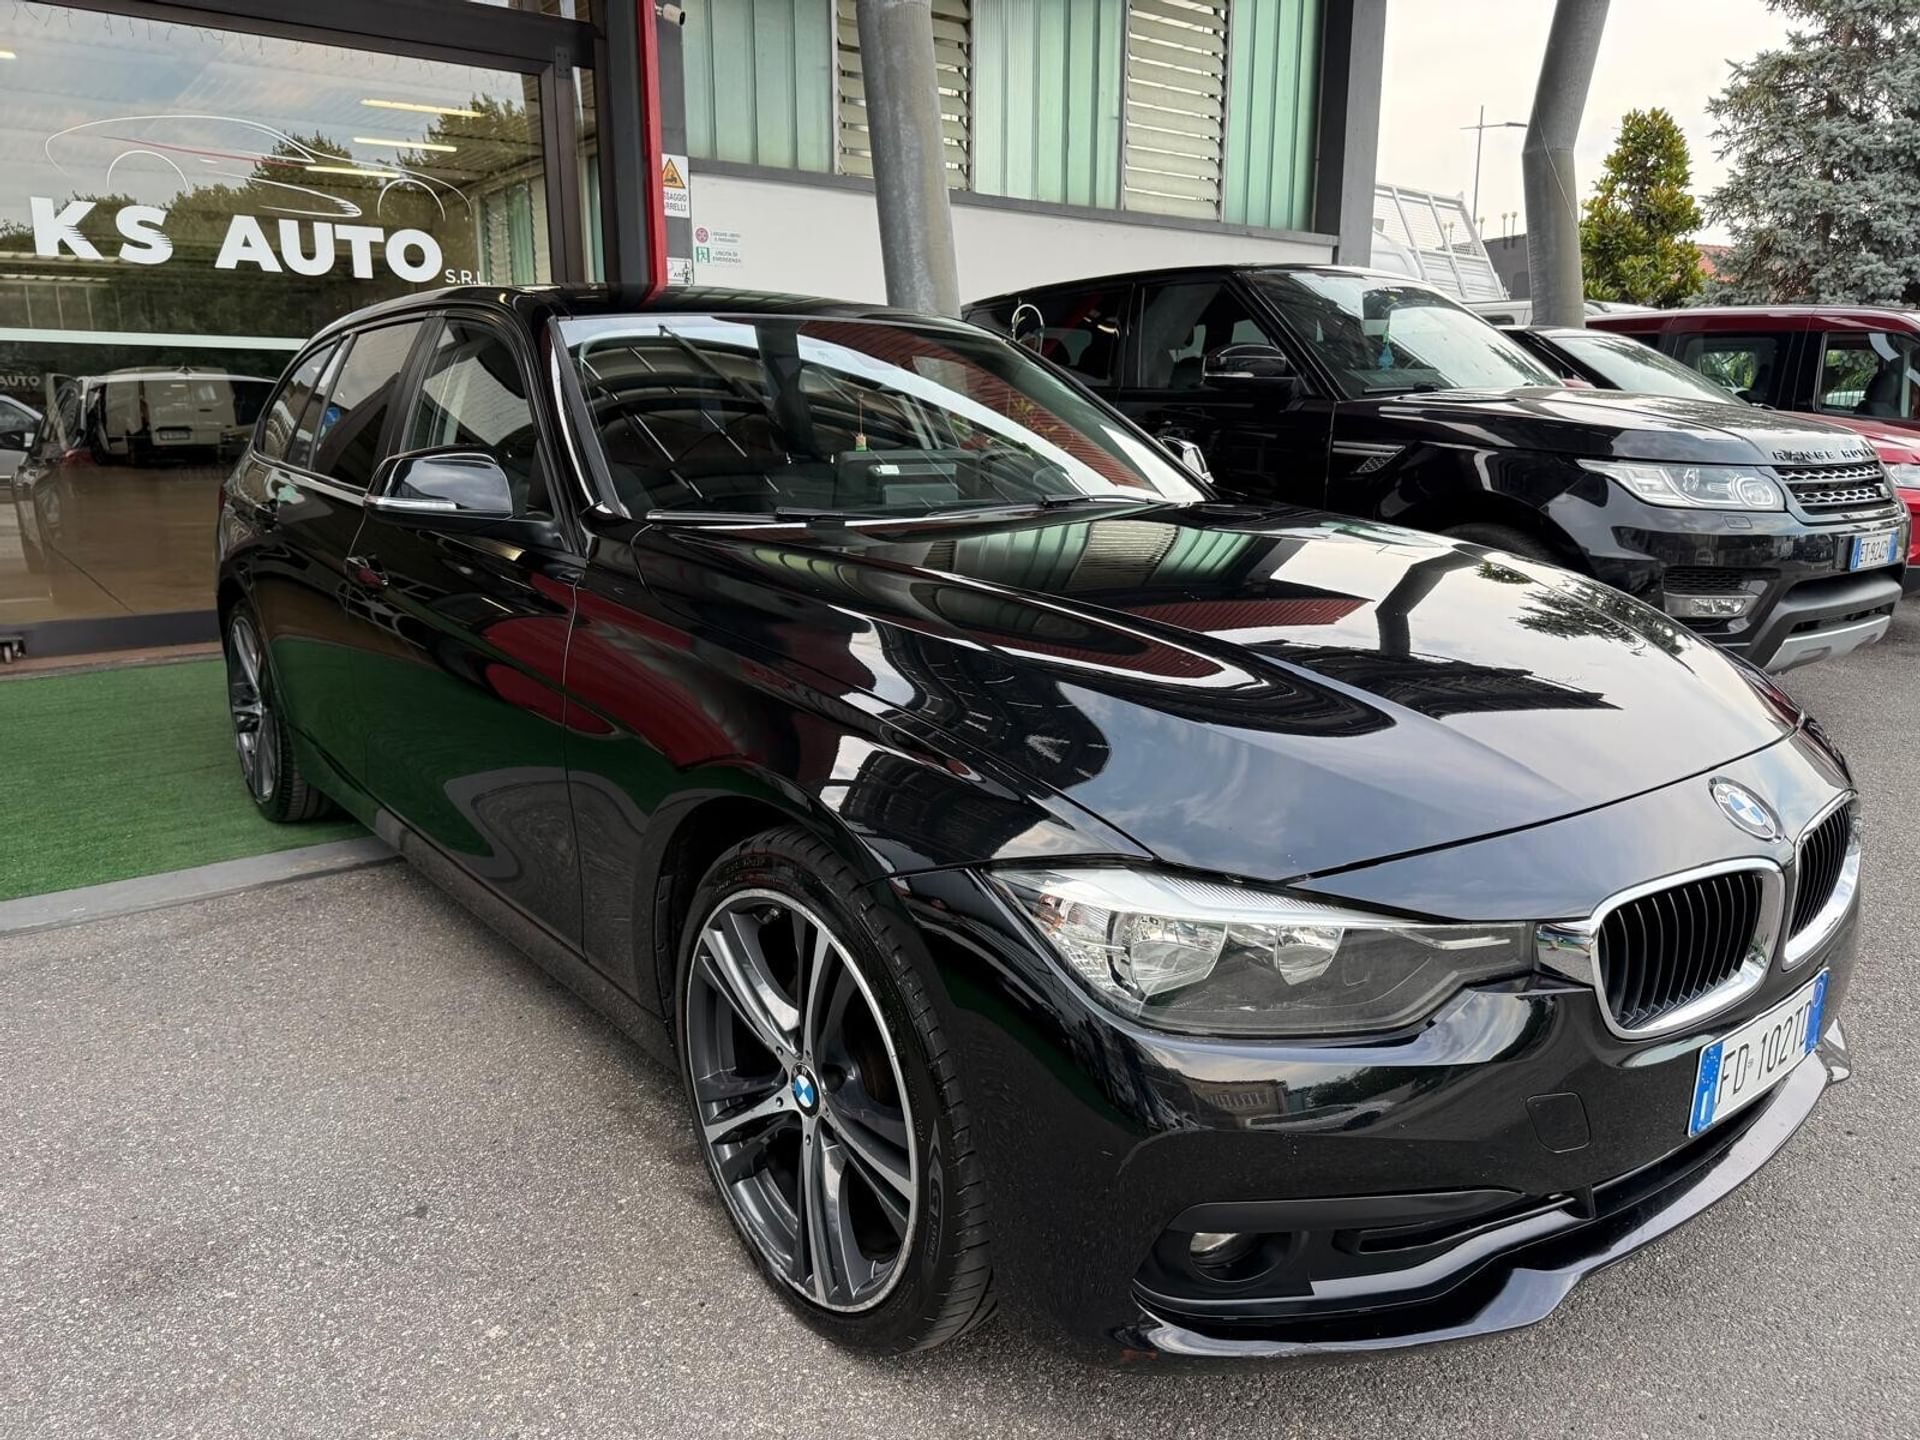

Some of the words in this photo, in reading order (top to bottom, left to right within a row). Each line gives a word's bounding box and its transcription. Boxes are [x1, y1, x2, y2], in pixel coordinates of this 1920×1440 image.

[30, 196, 175, 265] KS
[215, 215, 443, 284] AUTO
[1772, 450, 1835, 462] RANGE
